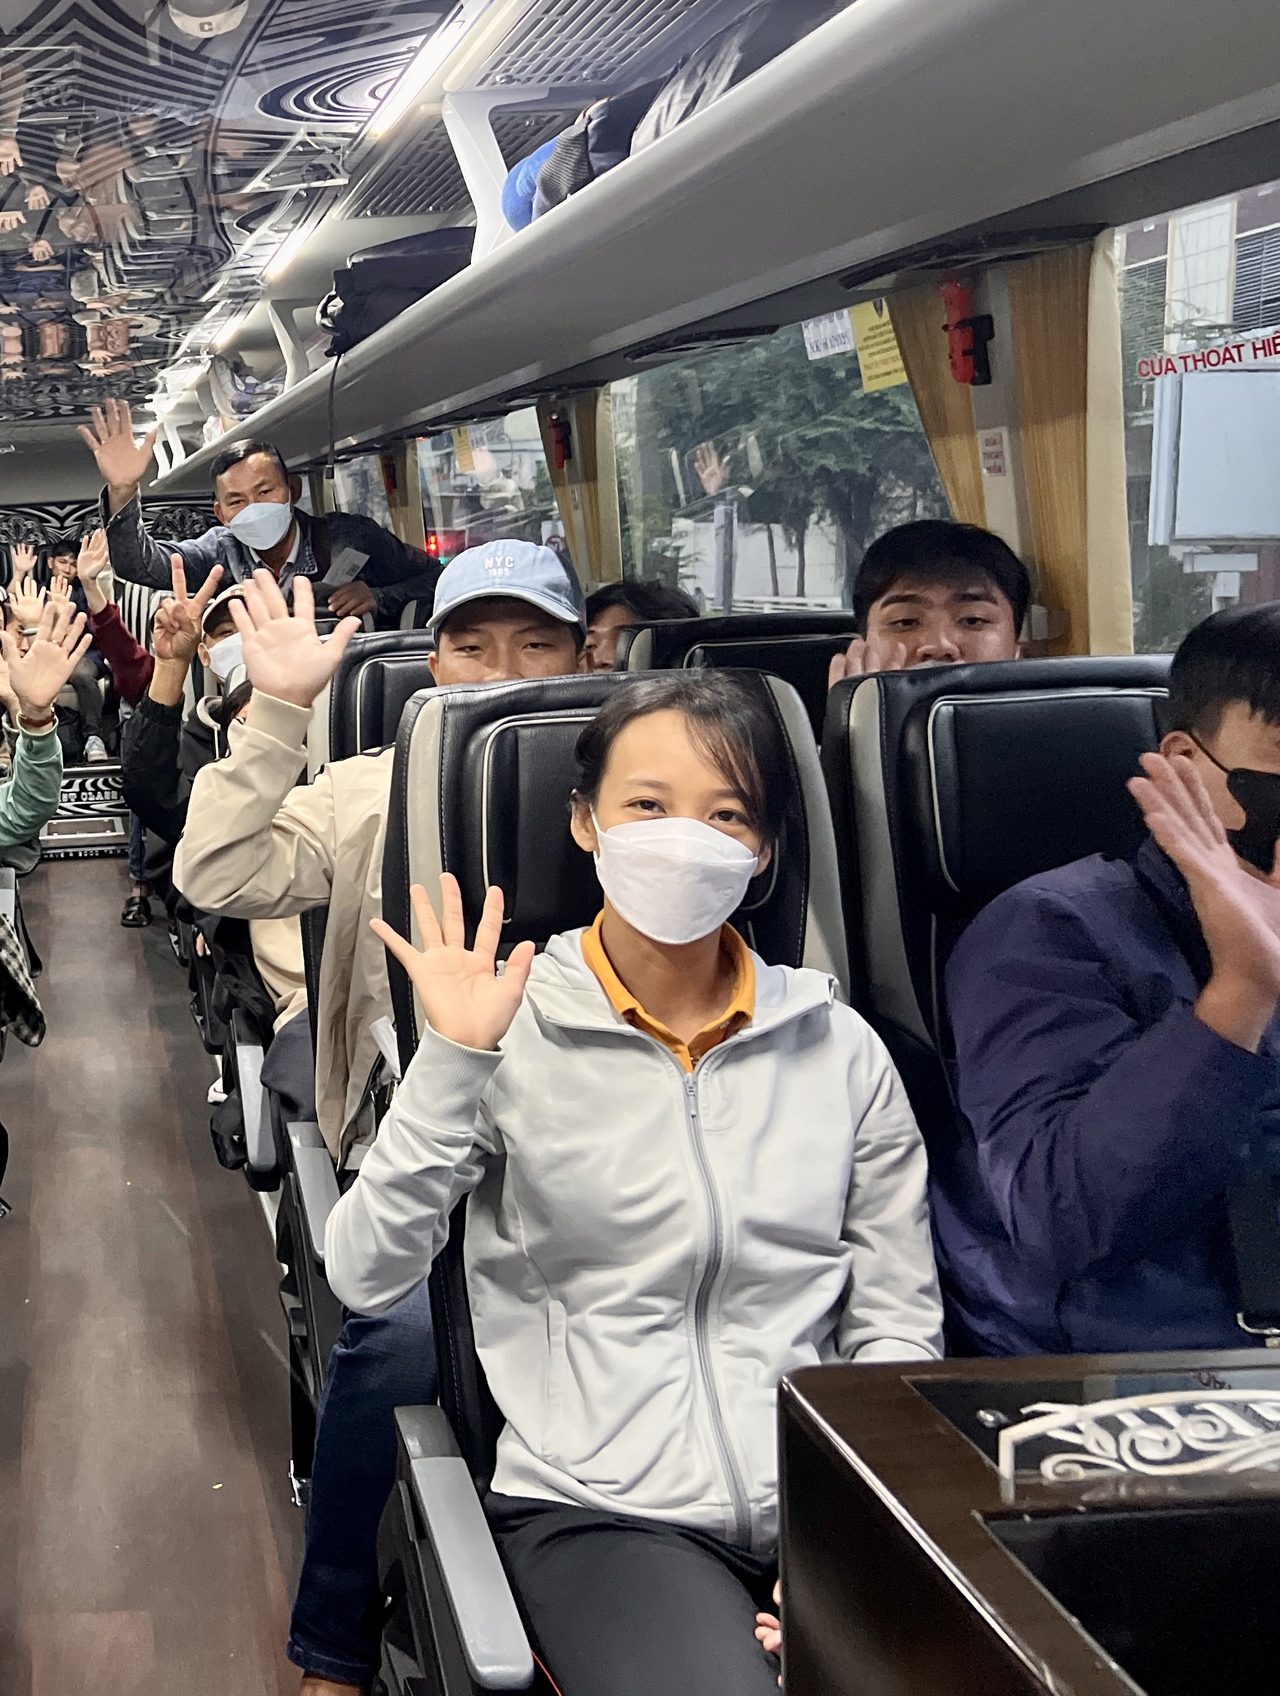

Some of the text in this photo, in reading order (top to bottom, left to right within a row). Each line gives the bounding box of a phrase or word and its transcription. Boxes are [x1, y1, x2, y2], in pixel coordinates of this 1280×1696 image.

[1137, 330, 1280, 377] CỬA THOÁT HIÊ
[484, 556, 514, 569] NYC
[488, 567, 511, 577] 1985
[61, 792, 77, 802] ST
